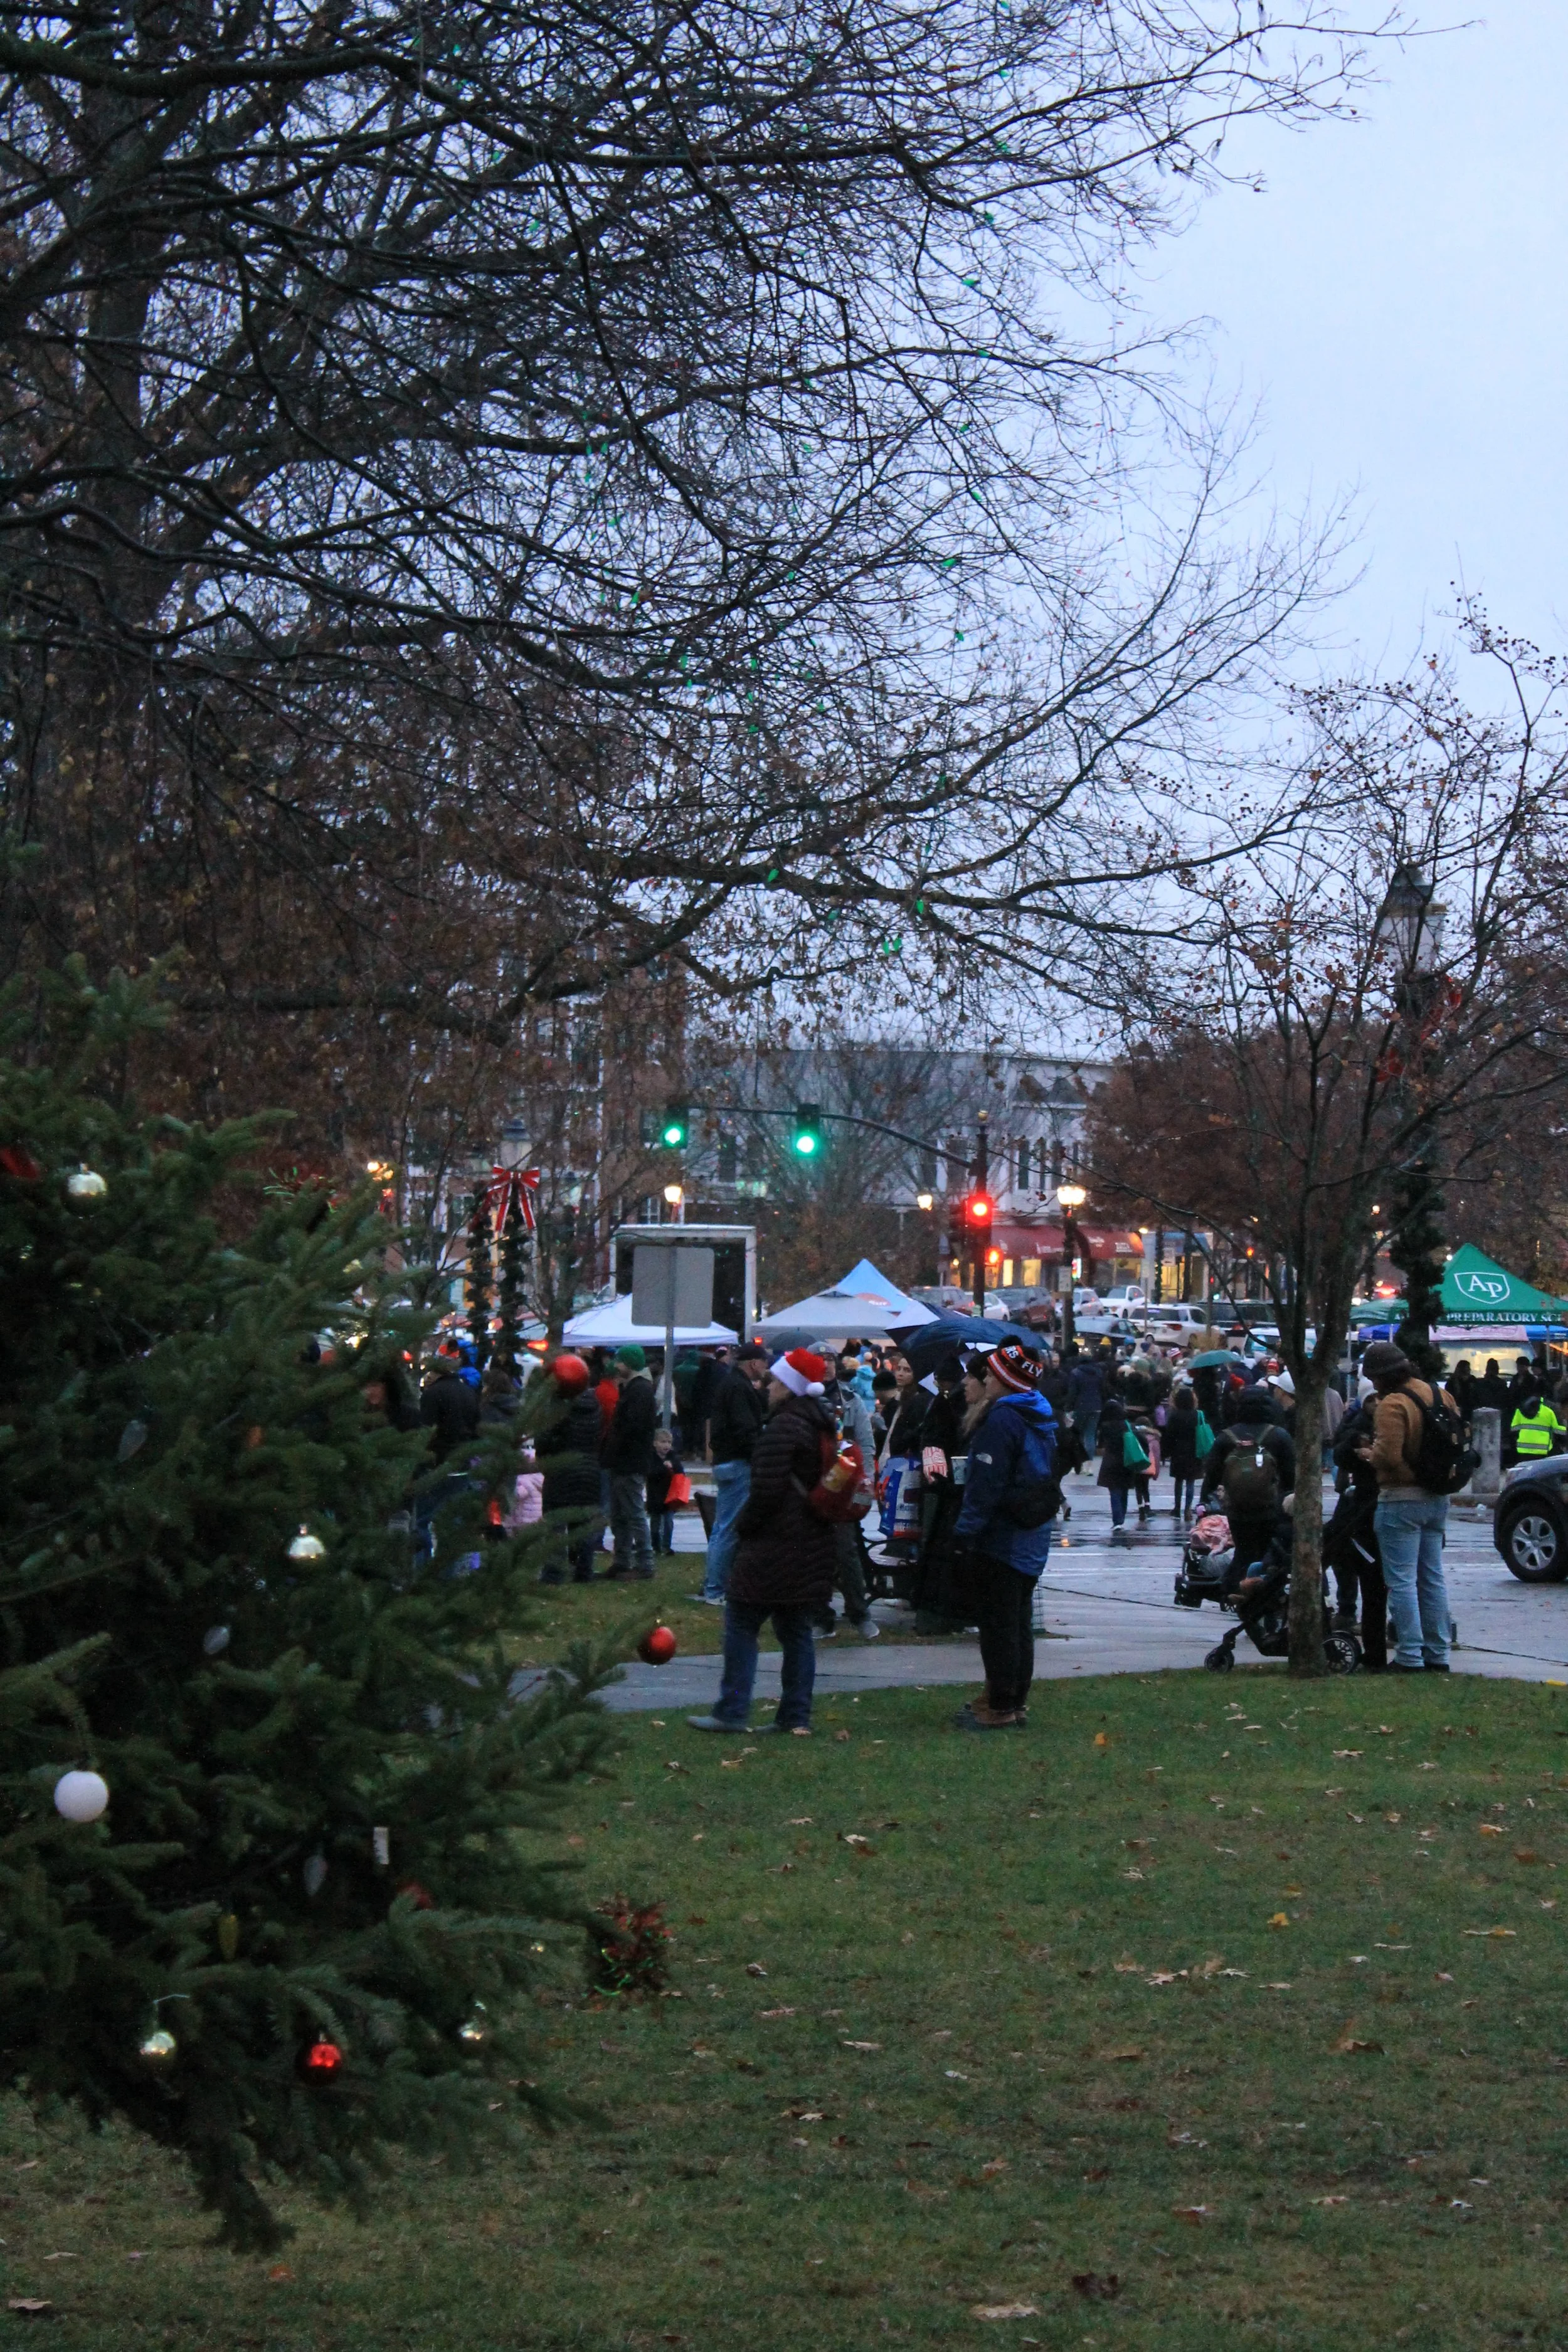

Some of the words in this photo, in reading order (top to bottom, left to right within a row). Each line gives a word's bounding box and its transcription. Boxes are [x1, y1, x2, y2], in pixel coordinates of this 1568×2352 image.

[1468, 1274, 1503, 1298] AP
[1446, 1312, 1537, 1322] PREPARATORY
[1004, 1345, 1019, 1359] RS
[1021, 1360, 1044, 1378] FLY
